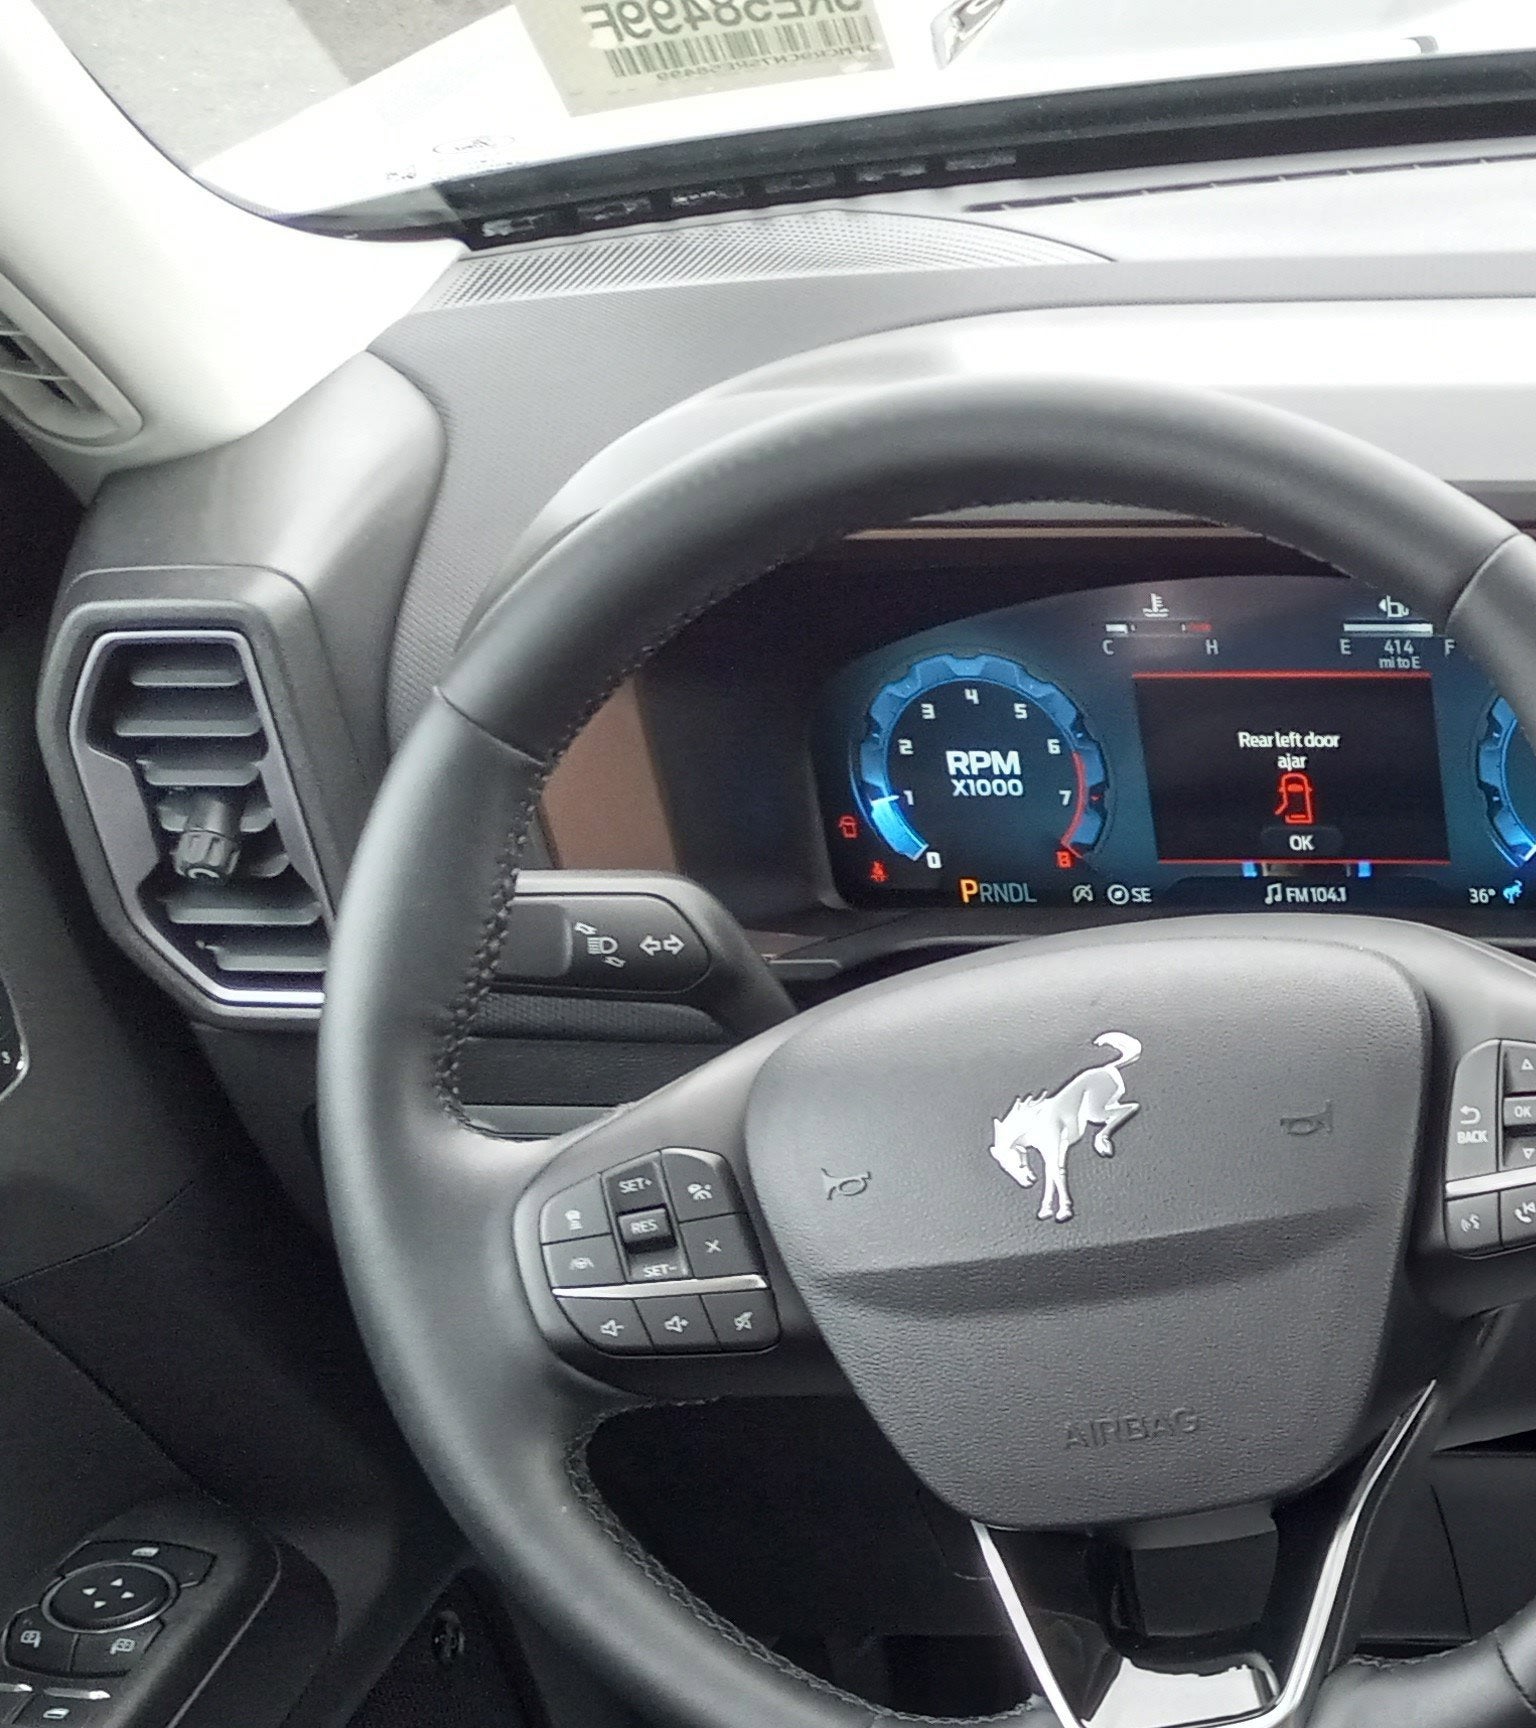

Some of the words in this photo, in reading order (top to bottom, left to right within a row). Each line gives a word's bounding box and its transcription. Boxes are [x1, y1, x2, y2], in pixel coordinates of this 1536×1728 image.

[1205, 640, 1219, 654] H
[1340, 639, 1351, 654] E
[1384, 640, 1414, 655] 414
[964, 689, 979, 704] 4
[921, 703, 936, 719] 3
[1014, 703, 1028, 719] 5
[899, 739, 914, 755] 2
[1048, 739, 1061, 755] 6
[1238, 732, 1273, 748] Rear
[1275, 732, 1302, 748] left
[1304, 732, 1340, 748] door
[946, 751, 1021, 775] RPM
[1277, 754, 1306, 770] ajar
[903, 790, 915, 805] 1
[1059, 790, 1071, 805] 7
[1289, 835, 1314, 851] OK
[925, 851, 941, 868] 0
[1131, 887, 1151, 901] SE
[1515, 1106, 1532, 1118] OK
[1457, 1130, 1488, 1144] BACK
[631, 1220, 658, 1235] RES
[1066, 1407, 1199, 1449] AIRBAG
